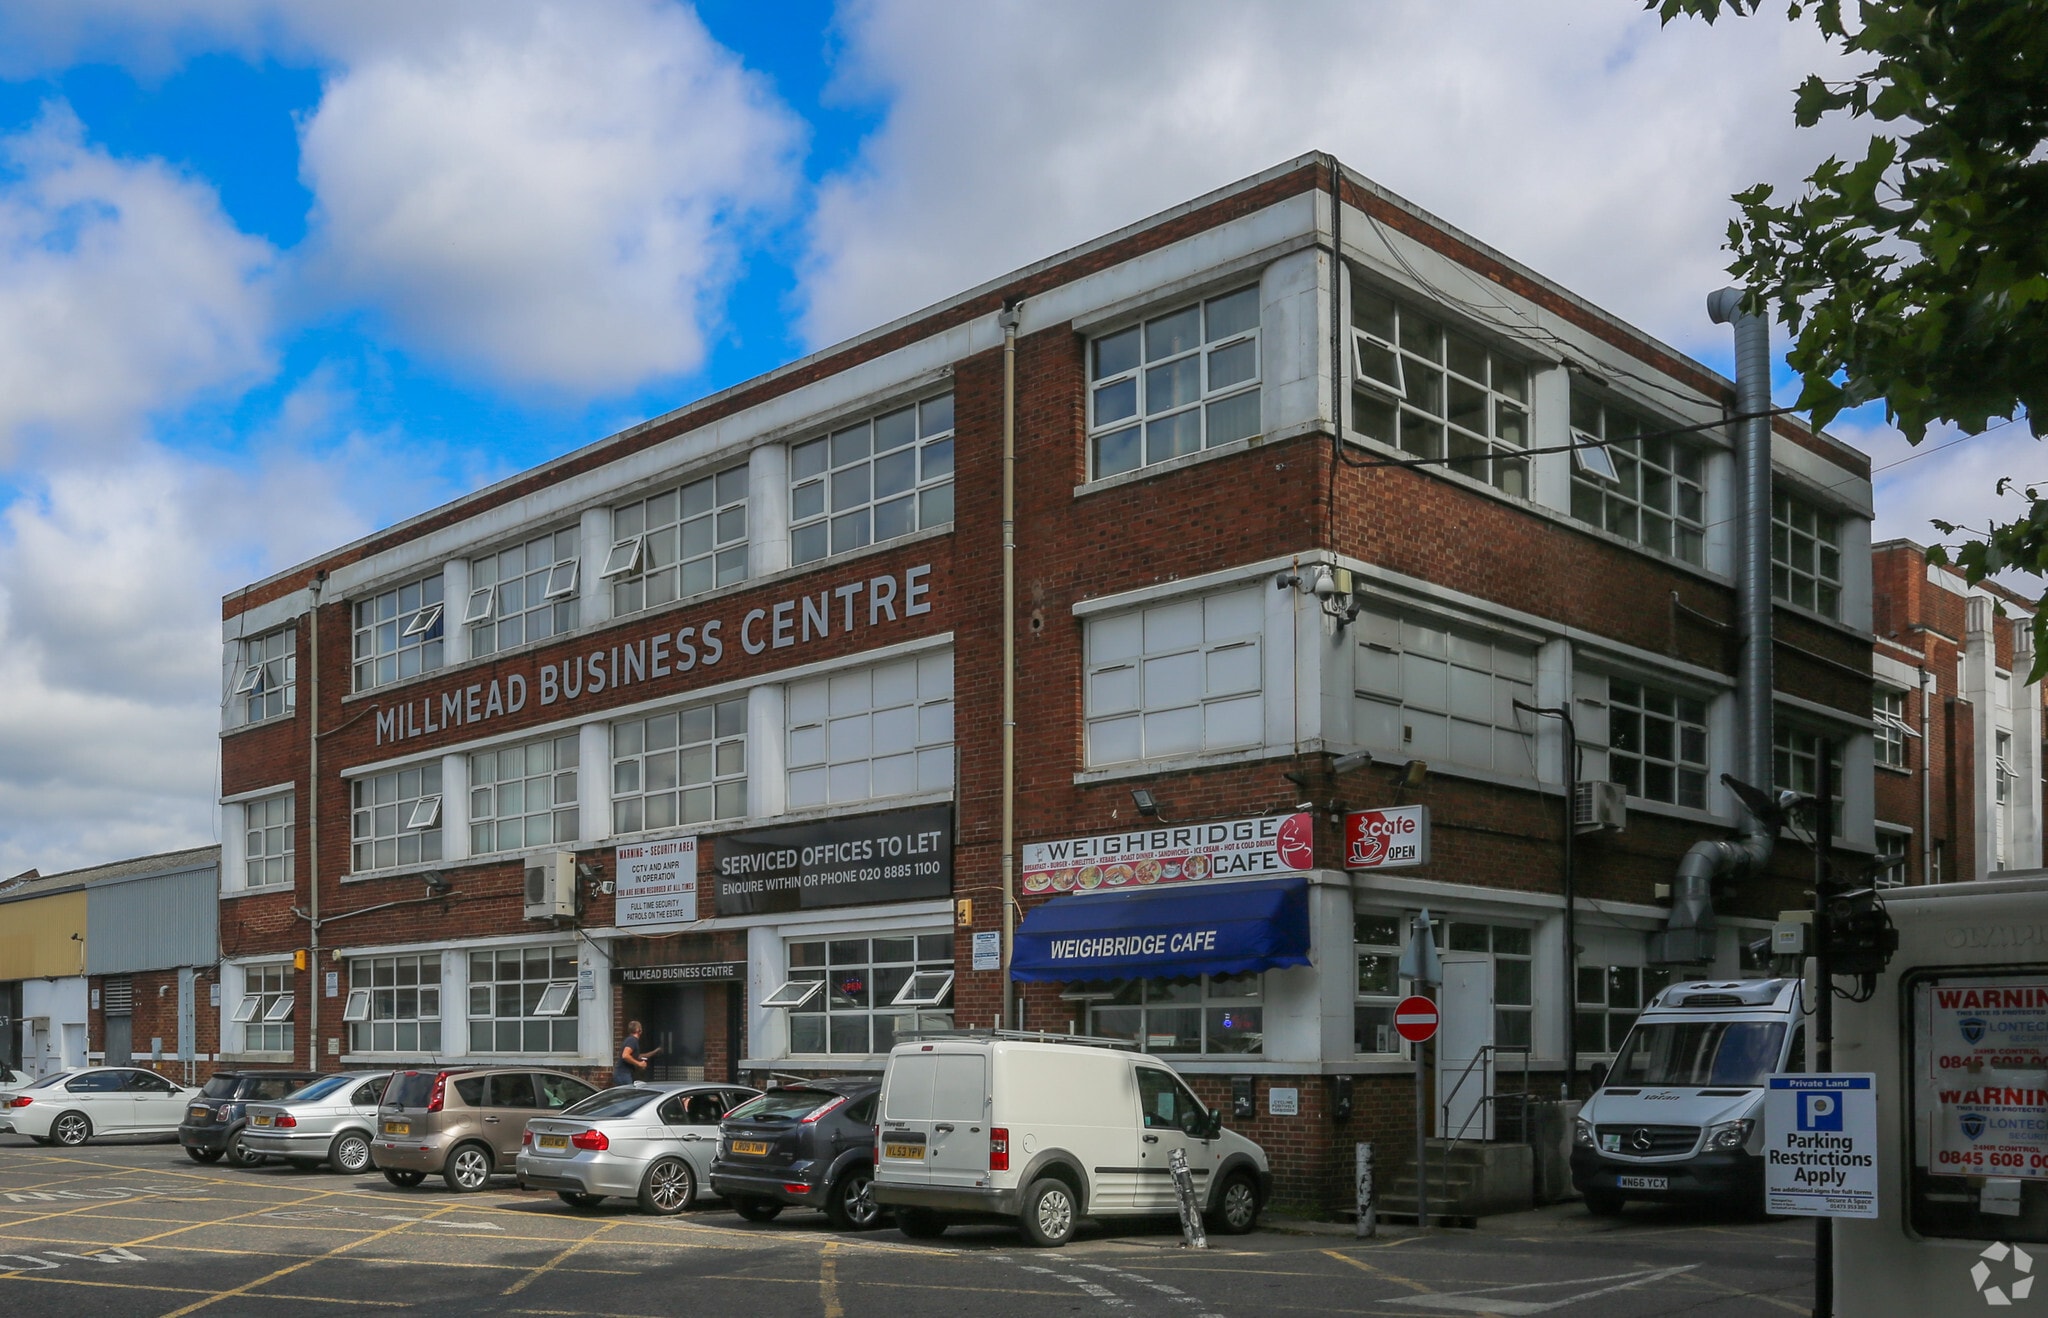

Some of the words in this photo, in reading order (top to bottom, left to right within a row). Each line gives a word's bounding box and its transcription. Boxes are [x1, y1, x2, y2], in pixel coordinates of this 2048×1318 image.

[375, 674, 527, 746] MILLMEAD
[540, 620, 724, 706] BUSINESS
[741, 564, 932, 655] CENTRE
[1369, 816, 1416, 837] cafe
[1047, 818, 1278, 860] WEIGHBRIDGE
[619, 847, 643, 859] WARNING
[650, 843, 677, 856] SECURITY
[679, 841, 694, 852] AREA
[721, 849, 797, 876] SERVICED
[801, 839, 872, 867] OFFICES
[877, 836, 902, 858] TO
[907, 831, 941, 855] LET
[1024, 863, 1047, 871] BREAKFAST
[1050, 861, 1067, 869] BURGER
[1099, 855, 1117, 863] KEBABS
[1120, 853, 1135, 861] ROAST
[1136, 851, 1154, 859] DINNER
[1158, 848, 1189, 857] SANDWICHES
[1202, 845, 1220, 853] CREAM
[1224, 843, 1235, 851] HOT
[1241, 841, 1255, 849] COLD
[1256, 839, 1276, 848] DRINKS
[1388, 845, 1415, 859] OPEN
[631, 864, 648, 873] CCTV
[649, 862, 662, 871] AND
[663, 861, 680, 870] ANPR
[1213, 850, 1278, 874] CAFE
[635, 875, 641, 883] IN
[642, 872, 676, 883] OPERATION
[722, 879, 764, 895] ENQUIRE
[765, 876, 801, 891] WITHIN
[803, 874, 818, 887] OR
[820, 869, 857, 885] PHONE
[859, 867, 881, 881] 020
[884, 864, 911, 879] 8885
[914, 860, 940, 876] 1100
[634, 887, 646, 895] BEING
[646, 885, 666, 894] RECORDED
[682, 883, 694, 891] TIMES
[630, 902, 642, 910] FULL
[643, 901, 654, 909] TIME
[655, 899, 680, 909] SECURITY
[626, 912, 647, 920] PATROLS
[656, 911, 666, 919] THE
[666, 909, 683, 918] ESTATE
[1051, 934, 1167, 959] WEIGHBRIDGE
[1170, 930, 1217, 953] CAFE
[623, 969, 662, 981] MILLMEAD
[663, 967, 700, 978] BUSINESS
[701, 965, 734, 977] CENTRE
[1989, 1022, 2048, 1032] LONTEC
[1806, 1095, 1835, 1128] P
[1989, 1119, 2048, 1130] LONTEC
[1787, 1133, 1853, 1153] Parking
[1998, 1145, 2041, 1153] CONTROL
[1769, 1149, 1872, 1167] Restrictions
[1939, 1150, 1984, 1166] 0845
[1990, 1152, 2024, 1168] 608
[1622, 1177, 1645, 1187] WN66
[1647, 1178, 1666, 1188] YCX
[1794, 1167, 1846, 1187] Apply
